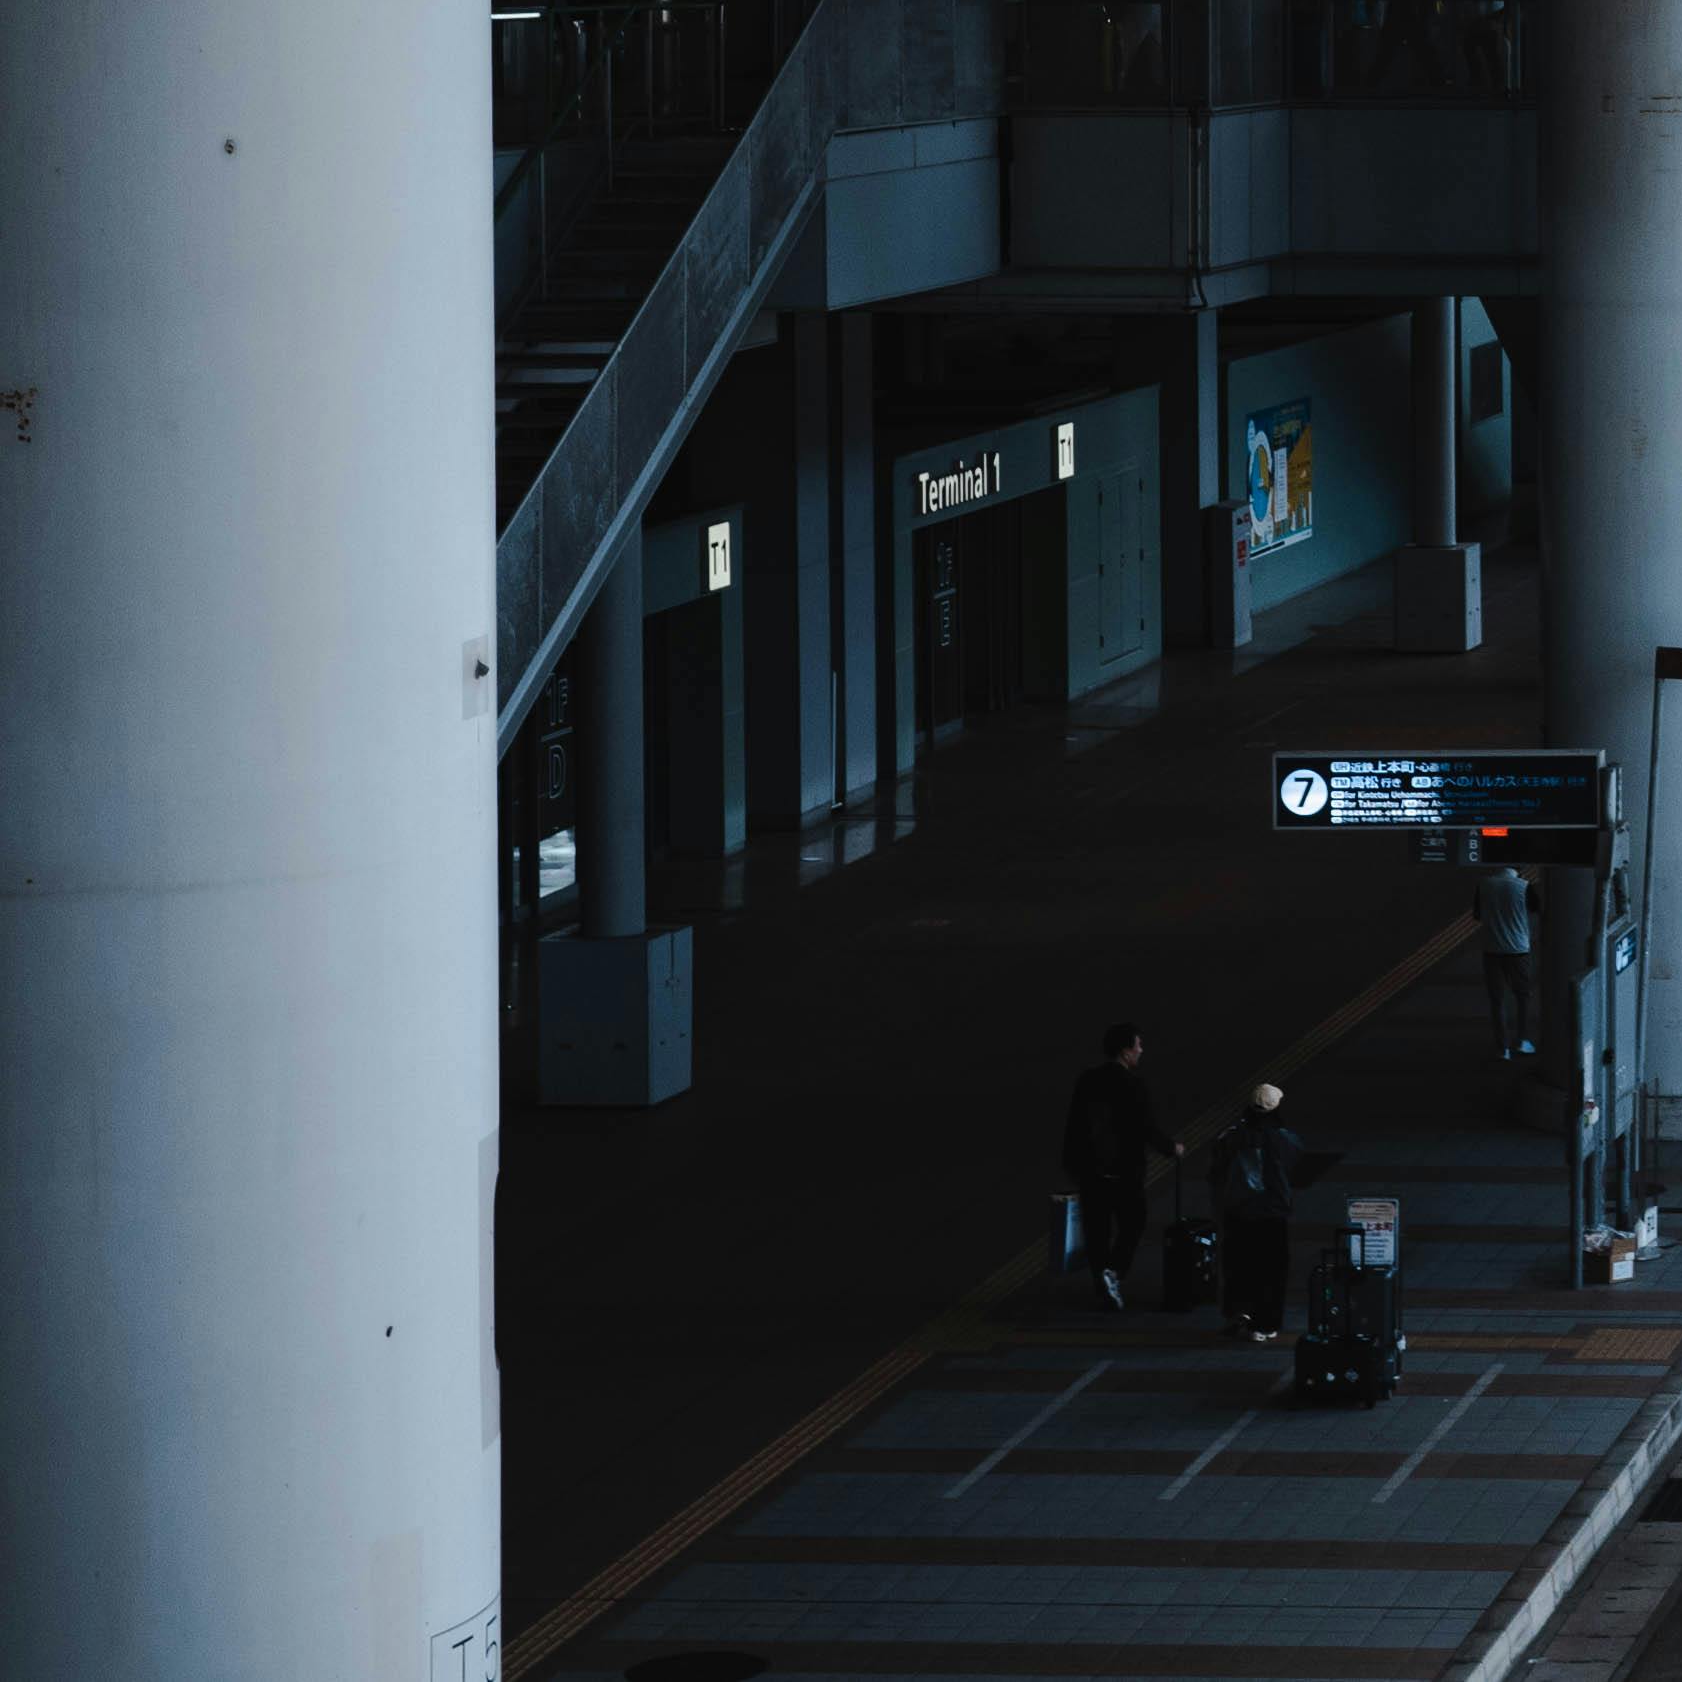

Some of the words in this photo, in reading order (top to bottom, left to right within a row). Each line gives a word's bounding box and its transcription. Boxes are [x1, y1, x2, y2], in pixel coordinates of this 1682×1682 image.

[919, 453, 988, 515] Terminal
[993, 452, 1001, 493] 1
[712, 540, 730, 576] T1
[1294, 777, 1314, 808] 7
